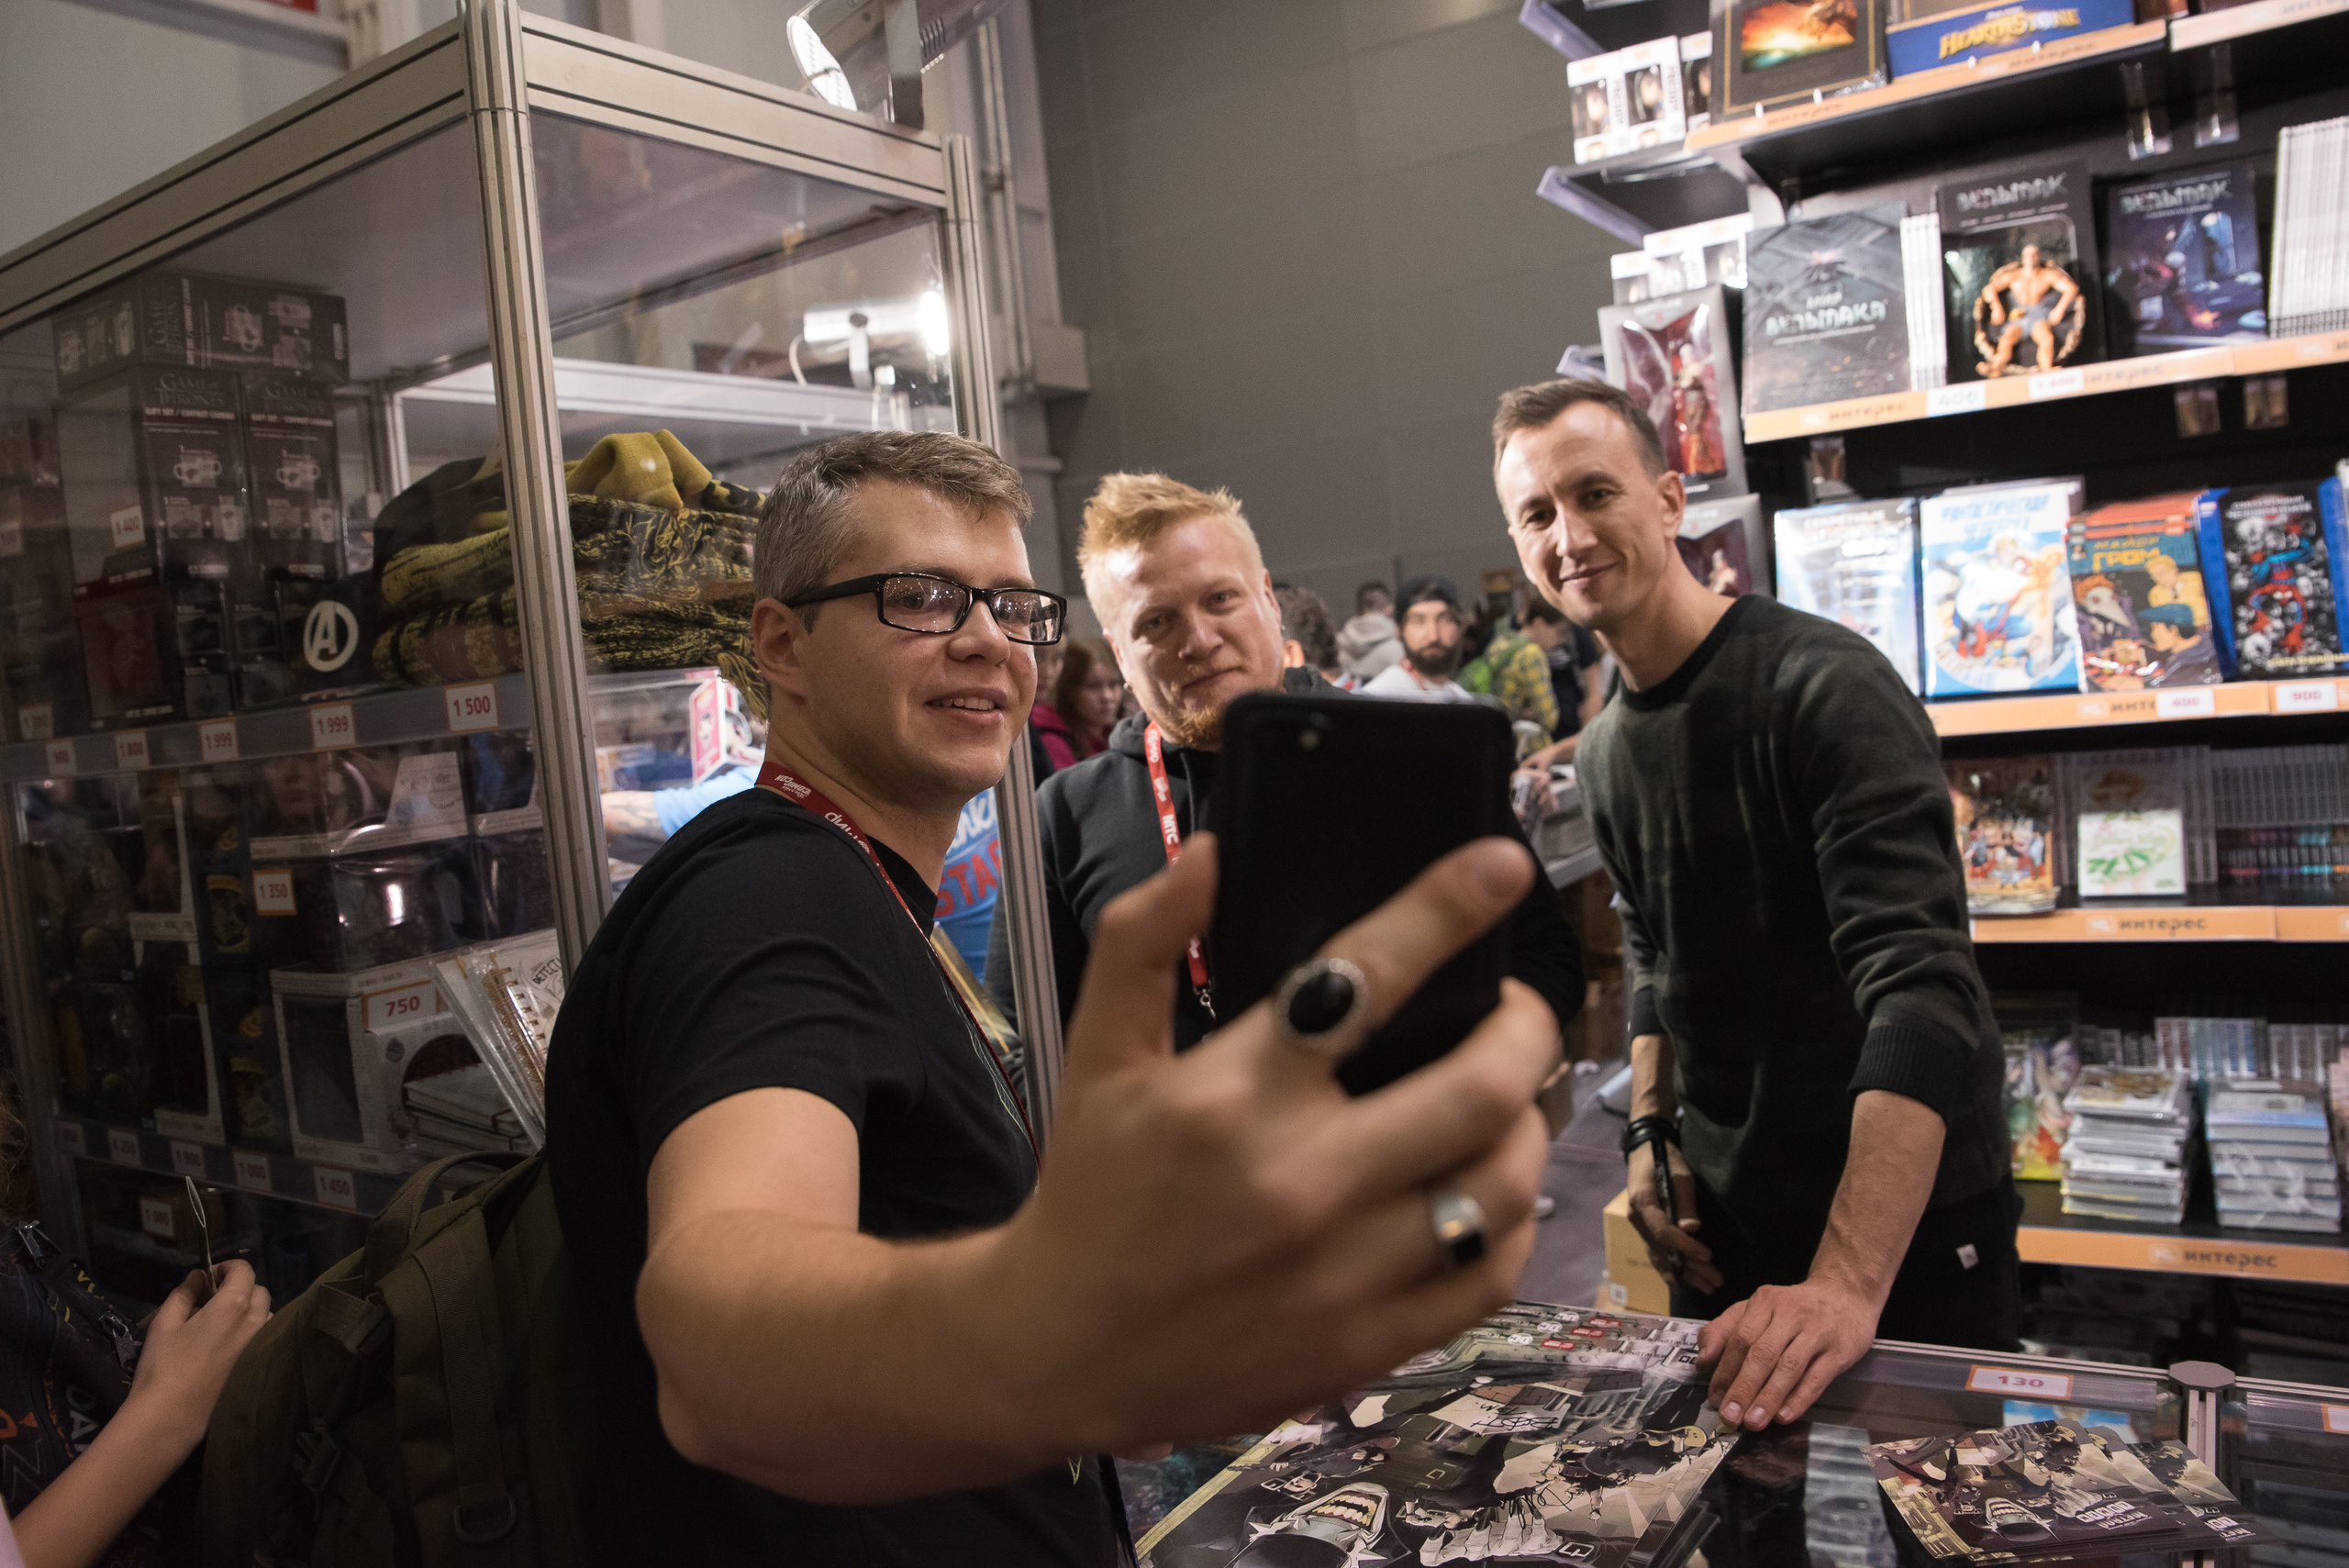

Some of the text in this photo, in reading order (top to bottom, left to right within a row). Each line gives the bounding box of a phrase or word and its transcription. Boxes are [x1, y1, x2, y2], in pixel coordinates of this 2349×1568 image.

[2092, 547, 2161, 574] ГРОМ
[465, 695, 491, 716] 500
[328, 716, 350, 732] 999
[2121, 917, 2208, 937] интерес
[385, 996, 420, 1017] 750
[2185, 1251, 2277, 1272] интерес
[1538, 1322, 1562, 1332] DC
[1509, 1334, 1532, 1345] DC
[1998, 1375, 2044, 1388] 130
